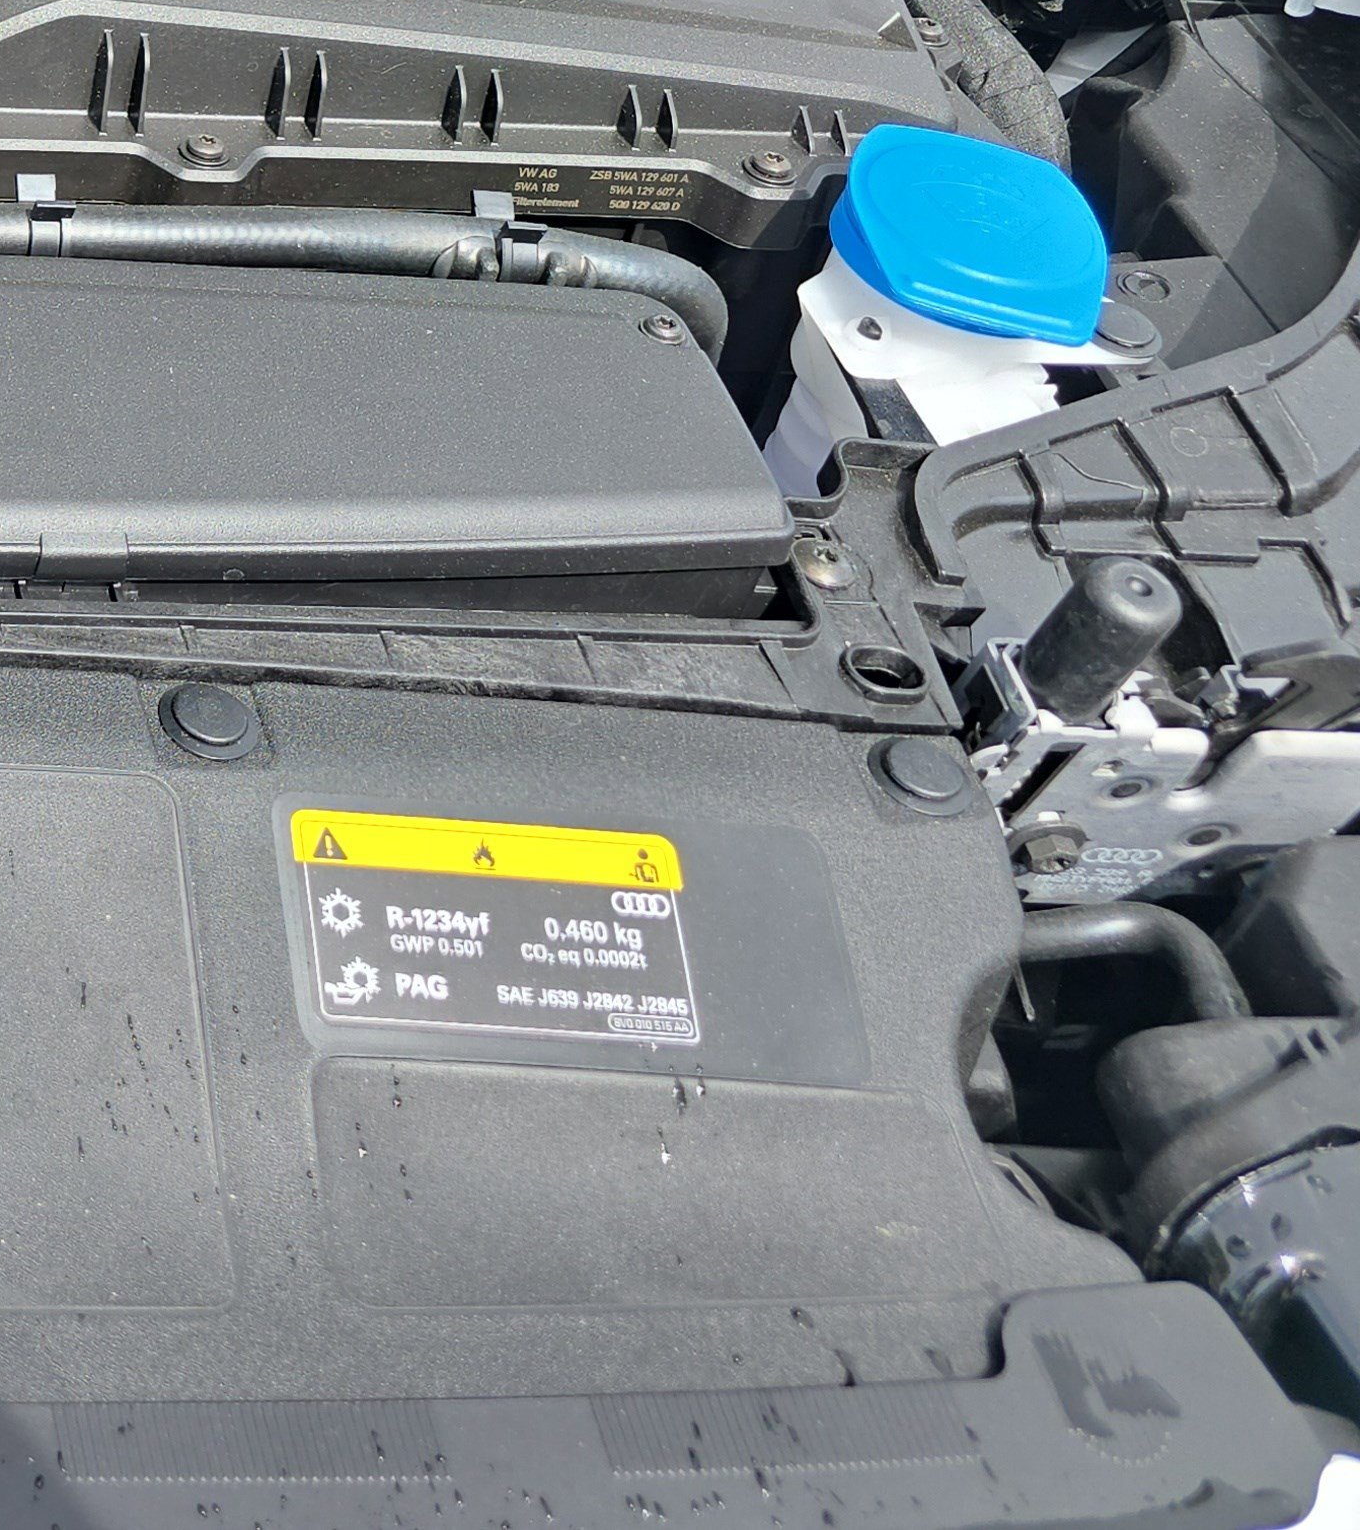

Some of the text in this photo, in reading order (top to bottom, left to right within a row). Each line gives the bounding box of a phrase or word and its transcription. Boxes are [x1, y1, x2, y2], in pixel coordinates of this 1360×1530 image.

[519, 167, 557, 179] VW AG
[589, 170, 689, 183] ZSB 5WA 129 601 A
[514, 182, 559, 193] 5WA 183
[609, 185, 684, 197] 5WA 129 607 A
[631, 200, 650, 210] 129
[651, 201, 670, 211] 620
[671, 201, 680, 211] D
[386, 906, 490, 939] R-1234yf
[390, 934, 433, 953] GWP
[614, 922, 643, 951] kg
[558, 950, 580, 969] eq
[395, 973, 448, 1000] PAG
[496, 985, 534, 1006] SAE
[538, 989, 579, 1008] J639
[583, 991, 634, 1011] J2842
